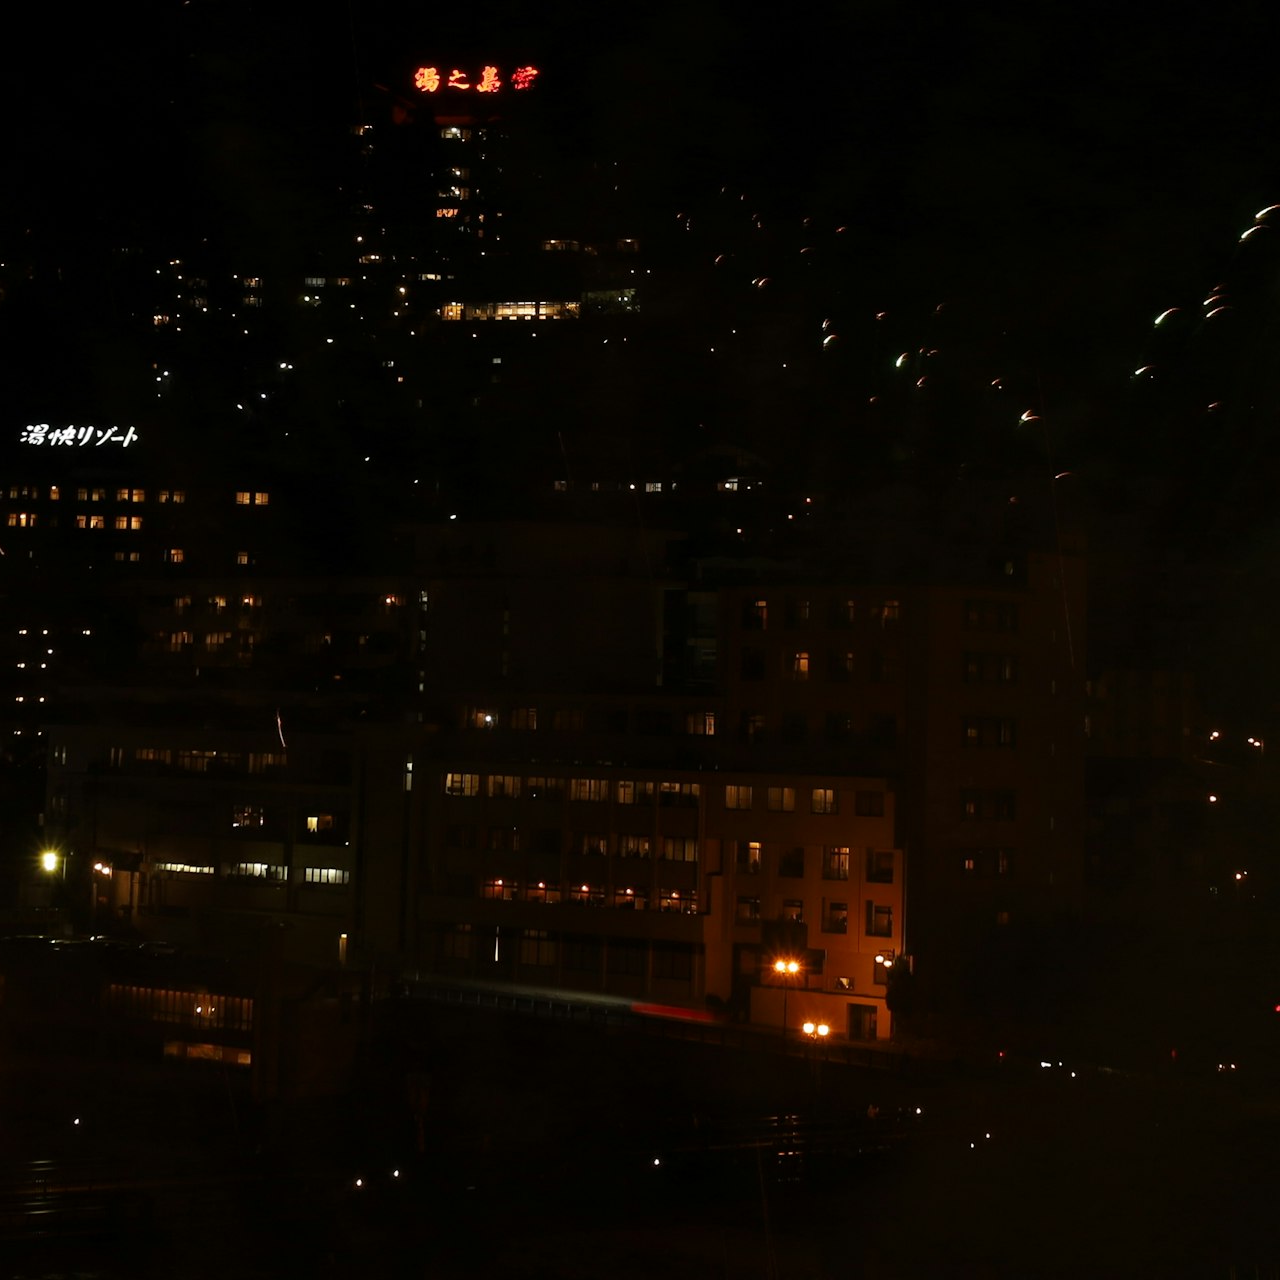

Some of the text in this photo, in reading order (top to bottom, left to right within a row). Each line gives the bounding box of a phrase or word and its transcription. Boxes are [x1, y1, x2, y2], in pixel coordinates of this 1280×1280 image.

[19, 423, 139, 448] 湯快リゾート
